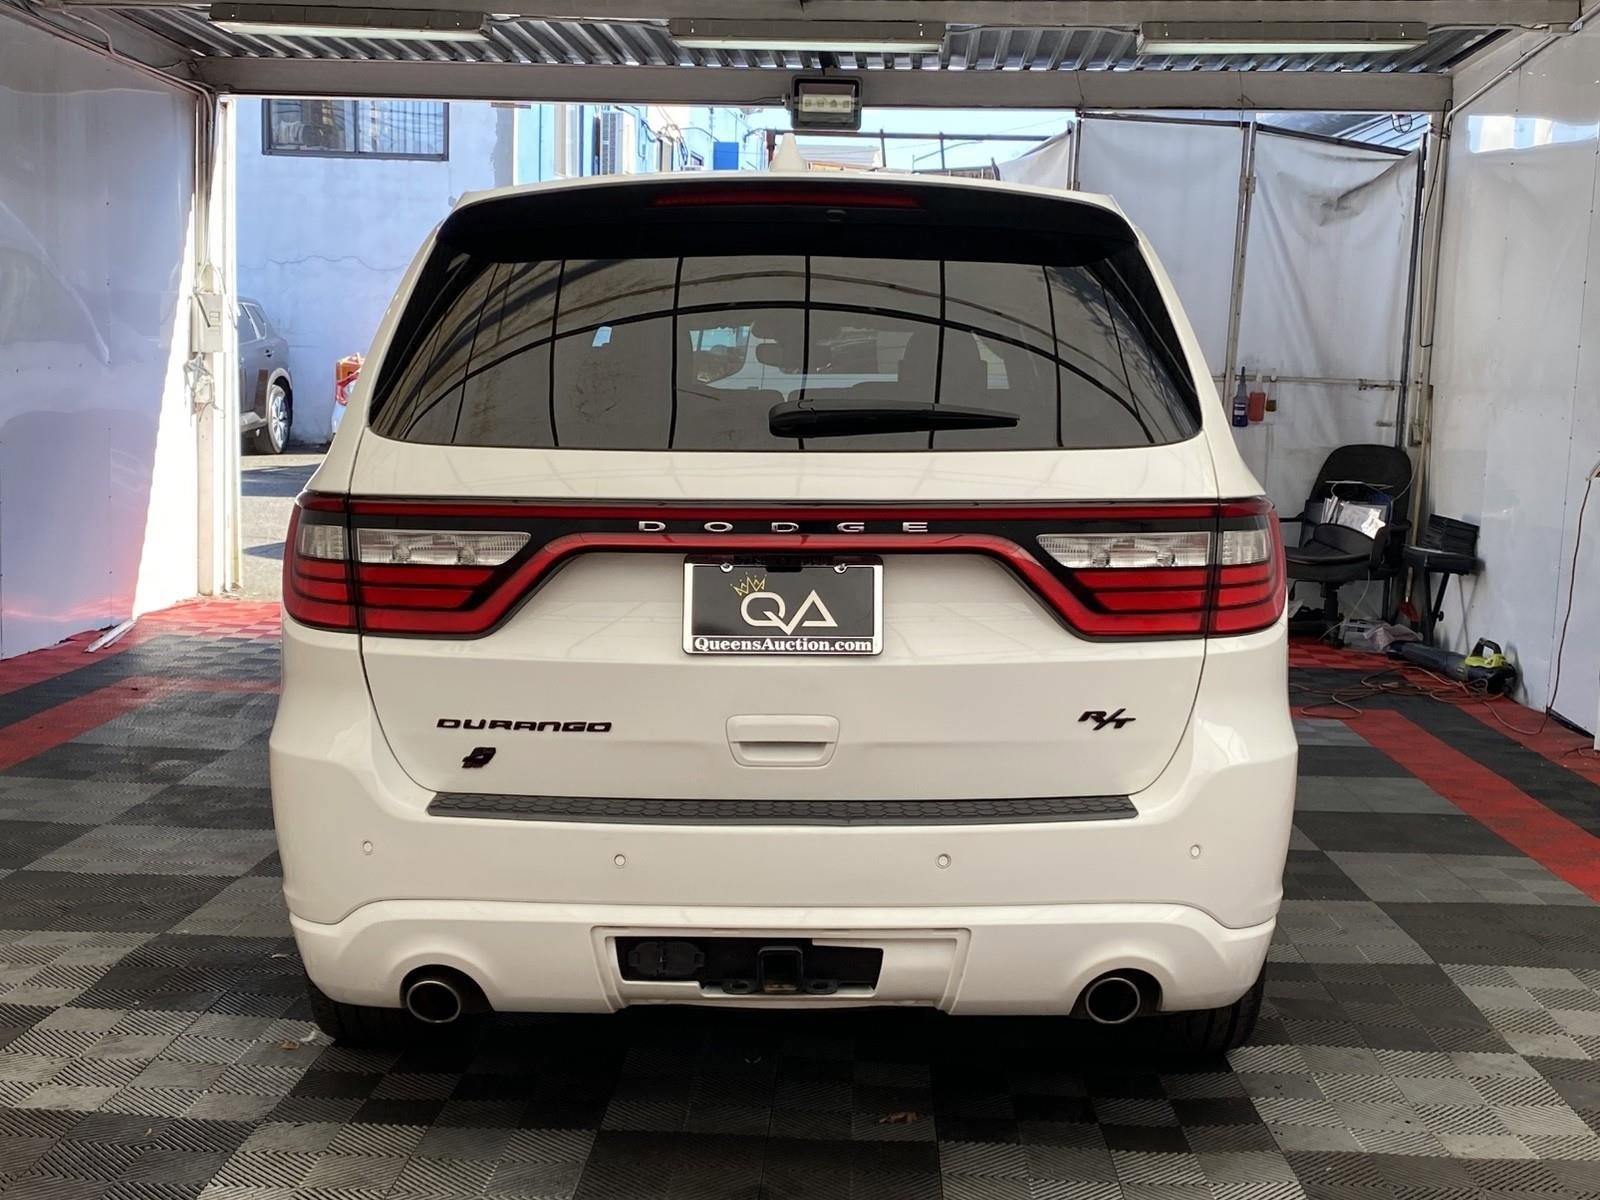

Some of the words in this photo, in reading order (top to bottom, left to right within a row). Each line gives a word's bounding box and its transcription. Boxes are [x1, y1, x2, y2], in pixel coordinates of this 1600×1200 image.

[638, 521, 929, 533] DODGE
[740, 589, 838, 636] QA
[694, 637, 872, 652] QueensAuction.com
[436, 718, 612, 732] DURANGO
[1078, 708, 1136, 731] R/T
